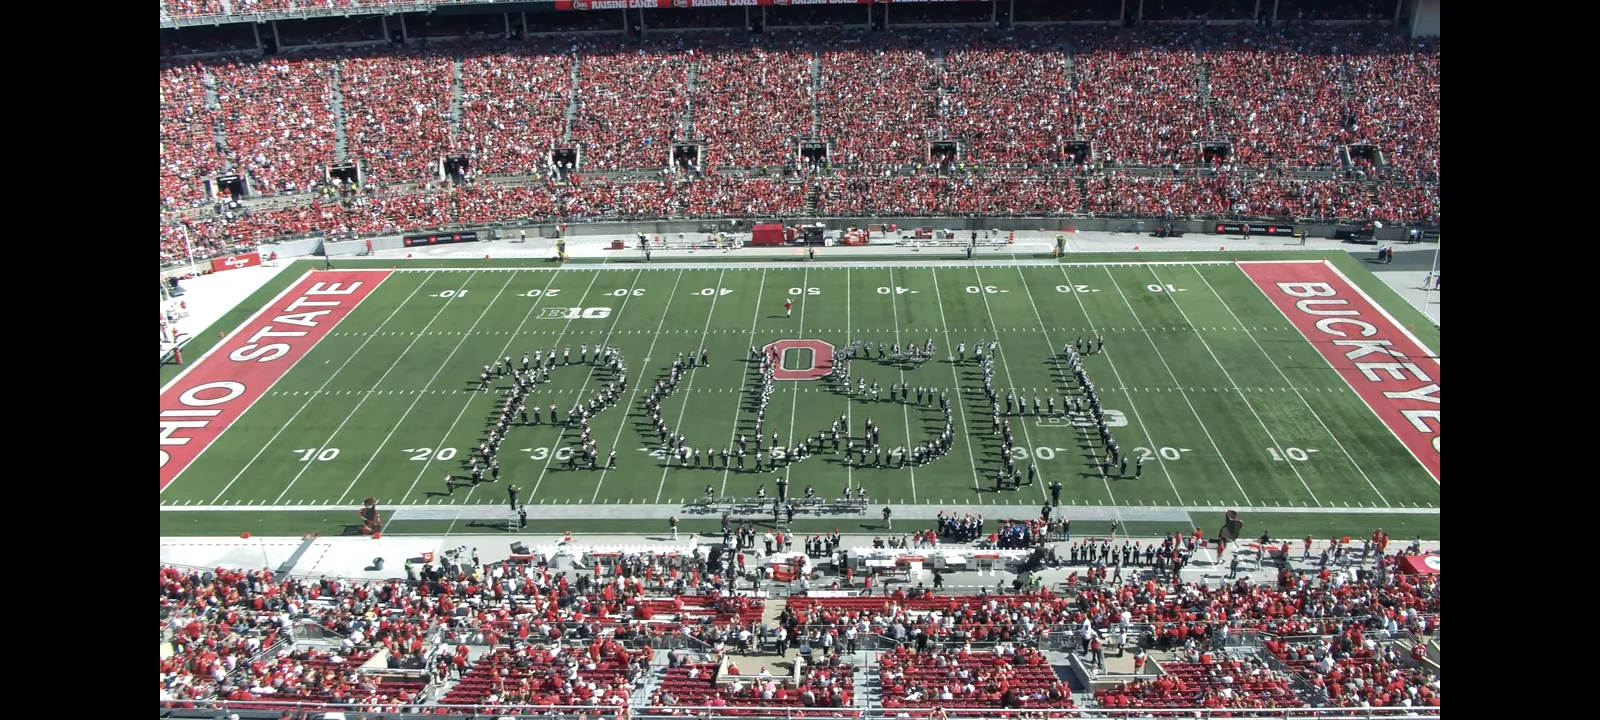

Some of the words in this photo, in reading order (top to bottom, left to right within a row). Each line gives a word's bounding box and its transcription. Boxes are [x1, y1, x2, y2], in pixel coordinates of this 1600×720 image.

[592, 1, 627, 9] RAISING
[629, 0, 658, 9] CANES
[613, 288, 646, 296] 30
[701, 288, 734, 296] 40
[788, 287, 821, 295] 50
[876, 286, 908, 295] 40
[965, 286, 999, 294] 30
[1055, 284, 1089, 293] 20
[1147, 283, 1178, 292] 10
[440, 289, 469, 297] 10
[526, 289, 561, 297] 20
[160, 381, 247, 469] HIO
[228, 281, 364, 363] STATE
[299, 448, 340, 461] 10
[409, 447, 457, 460] 20
[1011, 446, 1056, 460] 30
[1133, 446, 1181, 461] 20
[1265, 446, 1309, 461] 10
